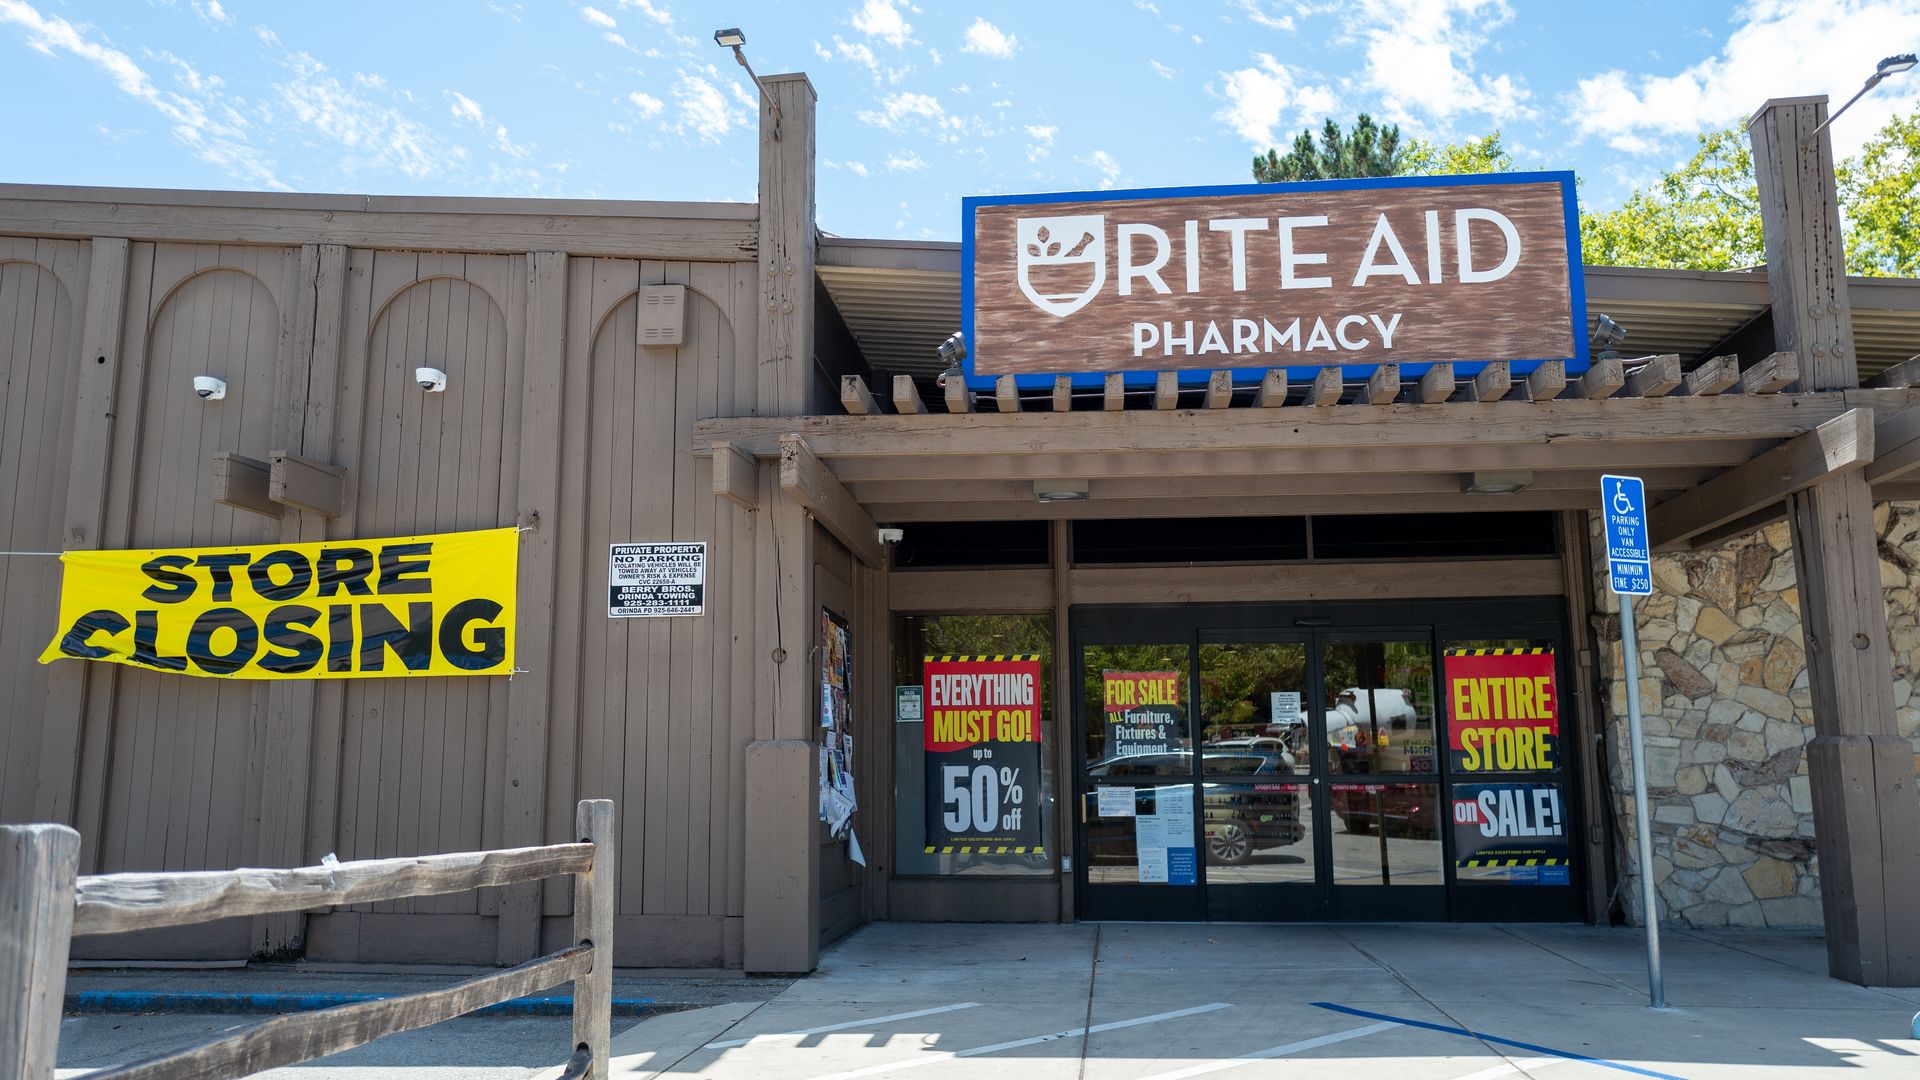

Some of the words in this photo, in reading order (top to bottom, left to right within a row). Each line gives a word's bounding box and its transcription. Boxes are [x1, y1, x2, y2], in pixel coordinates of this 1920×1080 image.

[1117, 216, 1333, 296] RITE
[1352, 208, 1522, 287] AID
[1133, 313, 1403, 357] PHARMACY
[1612, 516, 1639, 526] PARKING
[1618, 526, 1635, 537] ONLY
[654, 546, 700, 554] PROPERTY
[1620, 537, 1634, 547] VAN
[1611, 548, 1646, 558] ACCESSIBLE
[140, 542, 433, 604] STORE
[1617, 564, 1643, 576] MINIMUM
[661, 585, 695, 593] BROS.
[1614, 577, 1628, 589] FINE
[1631, 578, 1649, 591] $250
[656, 592, 696, 600] TOWING
[59, 598, 507, 675] CLOSING
[930, 673, 1034, 707] EVERYTHING
[1106, 680, 1136, 706] FOR
[1138, 678, 1177, 706] SALE
[1452, 676, 1553, 721] ENTIRE
[1109, 711, 1123, 724] ALL
[1124, 709, 1174, 725] Furniture,
[933, 710, 993, 743] MUST
[996, 709, 1032, 743] GO!
[1115, 725, 1157, 740] Fixtures
[1158, 725, 1167, 740] &
[972, 748, 983, 760] up
[983, 748, 993, 759] to
[1115, 741, 1168, 756] Equipment
[1460, 726, 1554, 772] STORE
[943, 764, 1024, 833] 50%
[1002, 808, 1023, 831] off
[1454, 801, 1478, 823] on
[1477, 788, 1562, 838] SALE!
